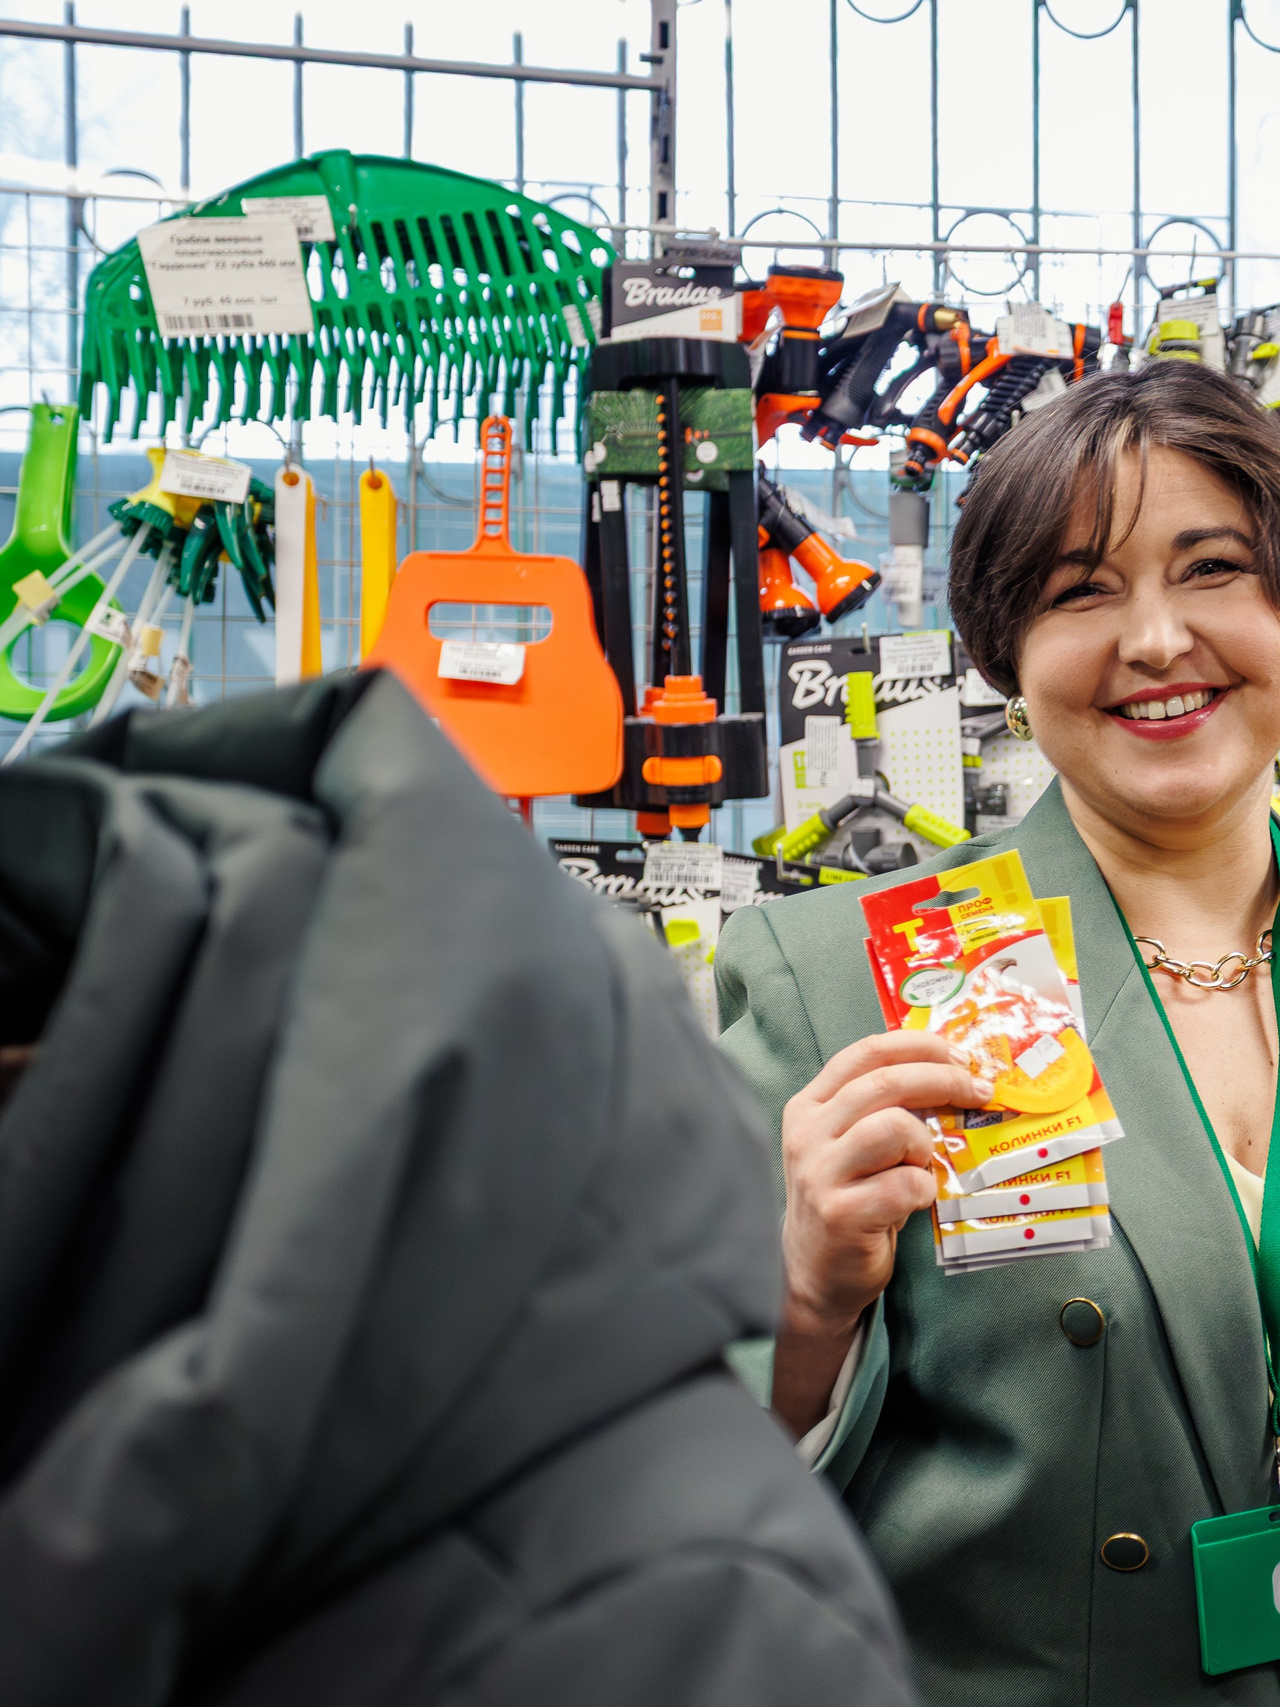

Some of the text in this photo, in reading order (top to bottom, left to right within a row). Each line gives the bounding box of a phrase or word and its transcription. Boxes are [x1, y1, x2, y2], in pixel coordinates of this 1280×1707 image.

[622, 277, 722, 308] Bradas
[957, 897, 993, 914] ПРОФ
[960, 905, 995, 920] СЕМЕНА
[910, 970, 954, 992] Знакомый
[988, 1115, 1083, 1155] КОЛИНКИ F1
[1056, 1171, 1071, 1181] F1
